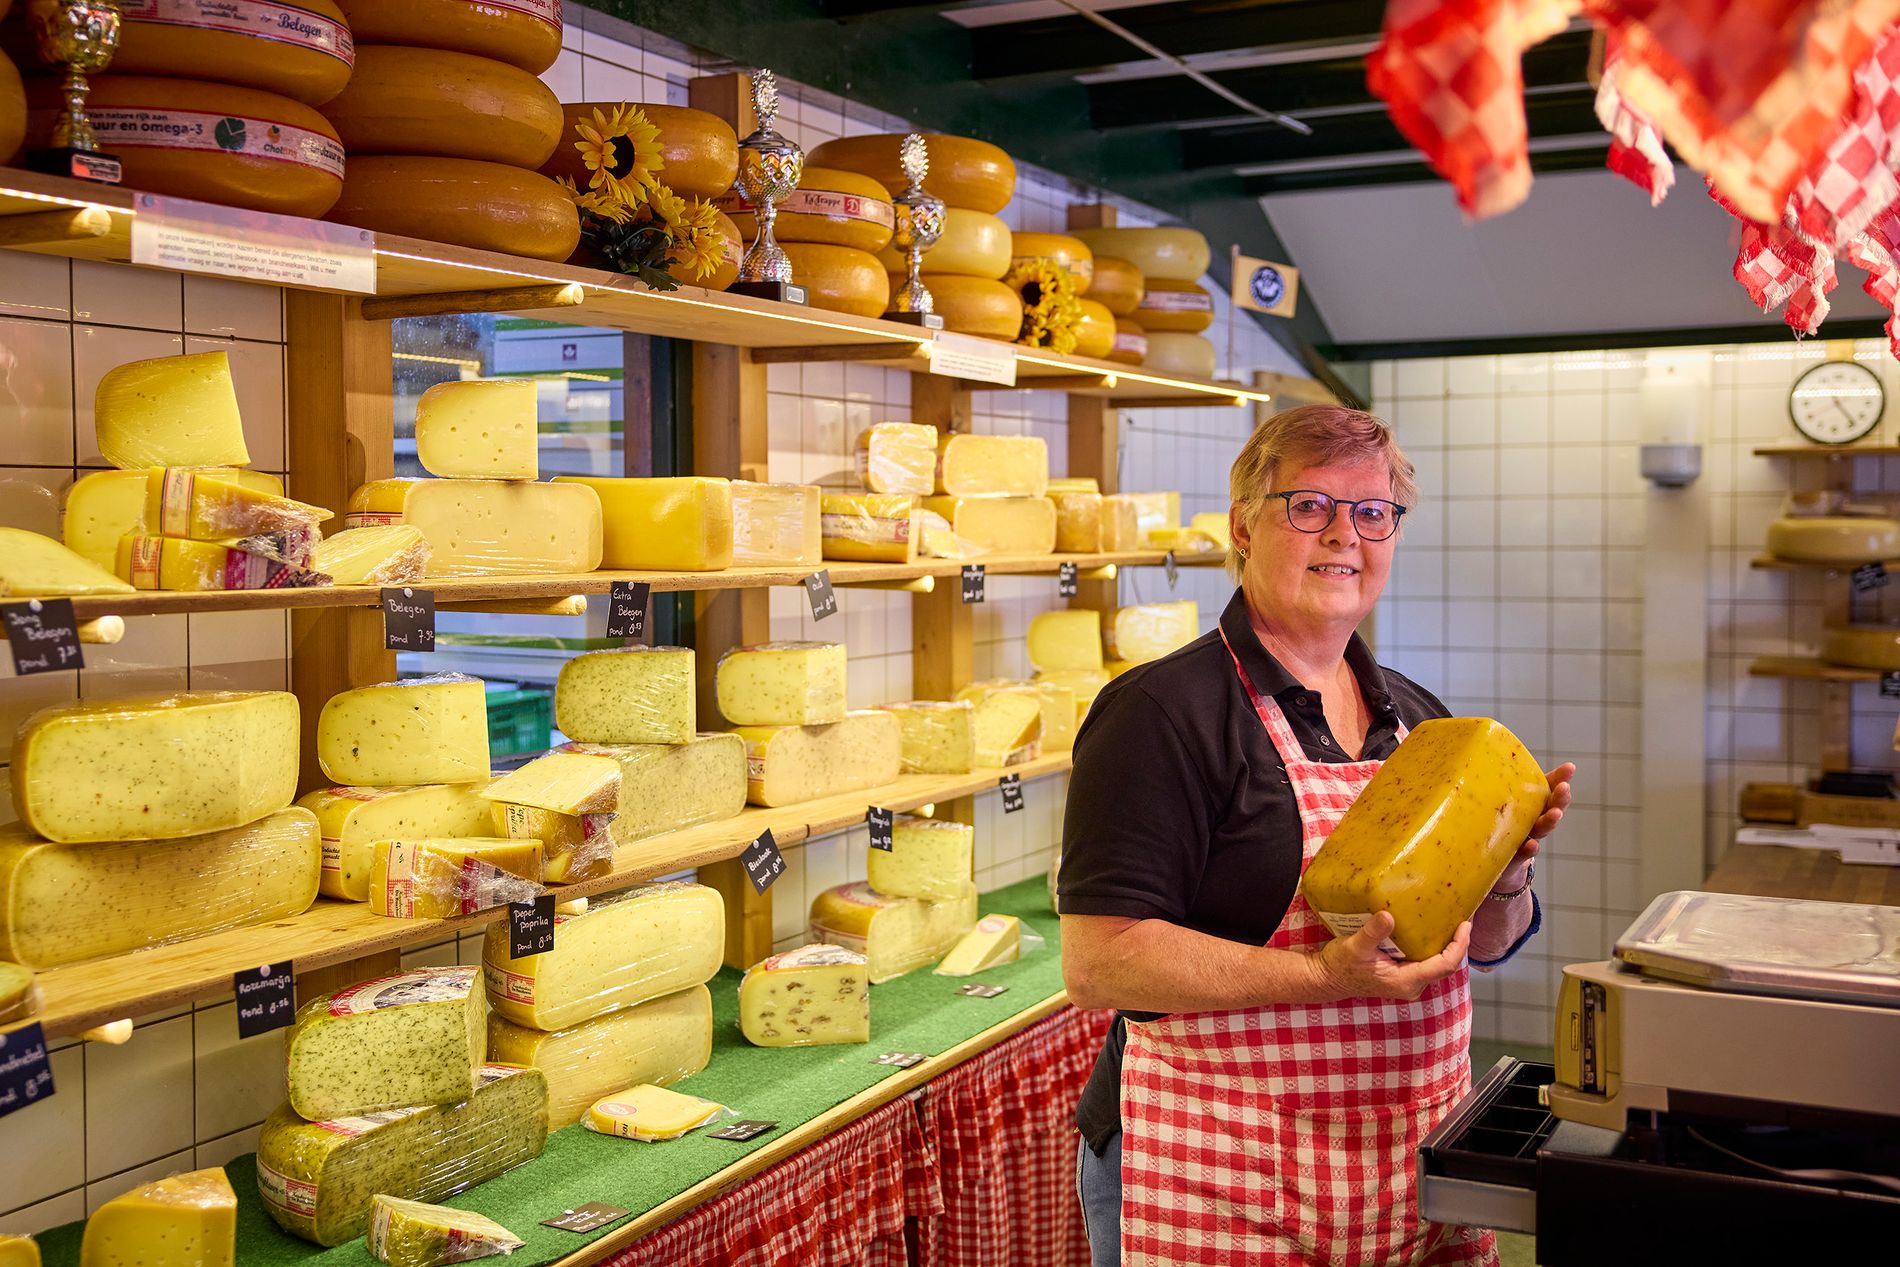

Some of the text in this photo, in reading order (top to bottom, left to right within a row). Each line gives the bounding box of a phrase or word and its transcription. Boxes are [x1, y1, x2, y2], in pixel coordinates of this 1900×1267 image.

[277, 12, 322, 39] Belegen
[120, 122, 137, 131] en
[141, 122, 203, 136] omega-3
[612, 587, 632, 600] Extra
[388, 598, 426, 619] Belegen
[617, 604, 643, 621] Belegen
[23, 627, 72, 643] Belegen
[390, 633, 408, 646] pond
[609, 626, 624, 637] pond
[19, 653, 50, 673] pond
[748, 847, 772, 872] Bieslook
[757, 867, 771, 887] pond
